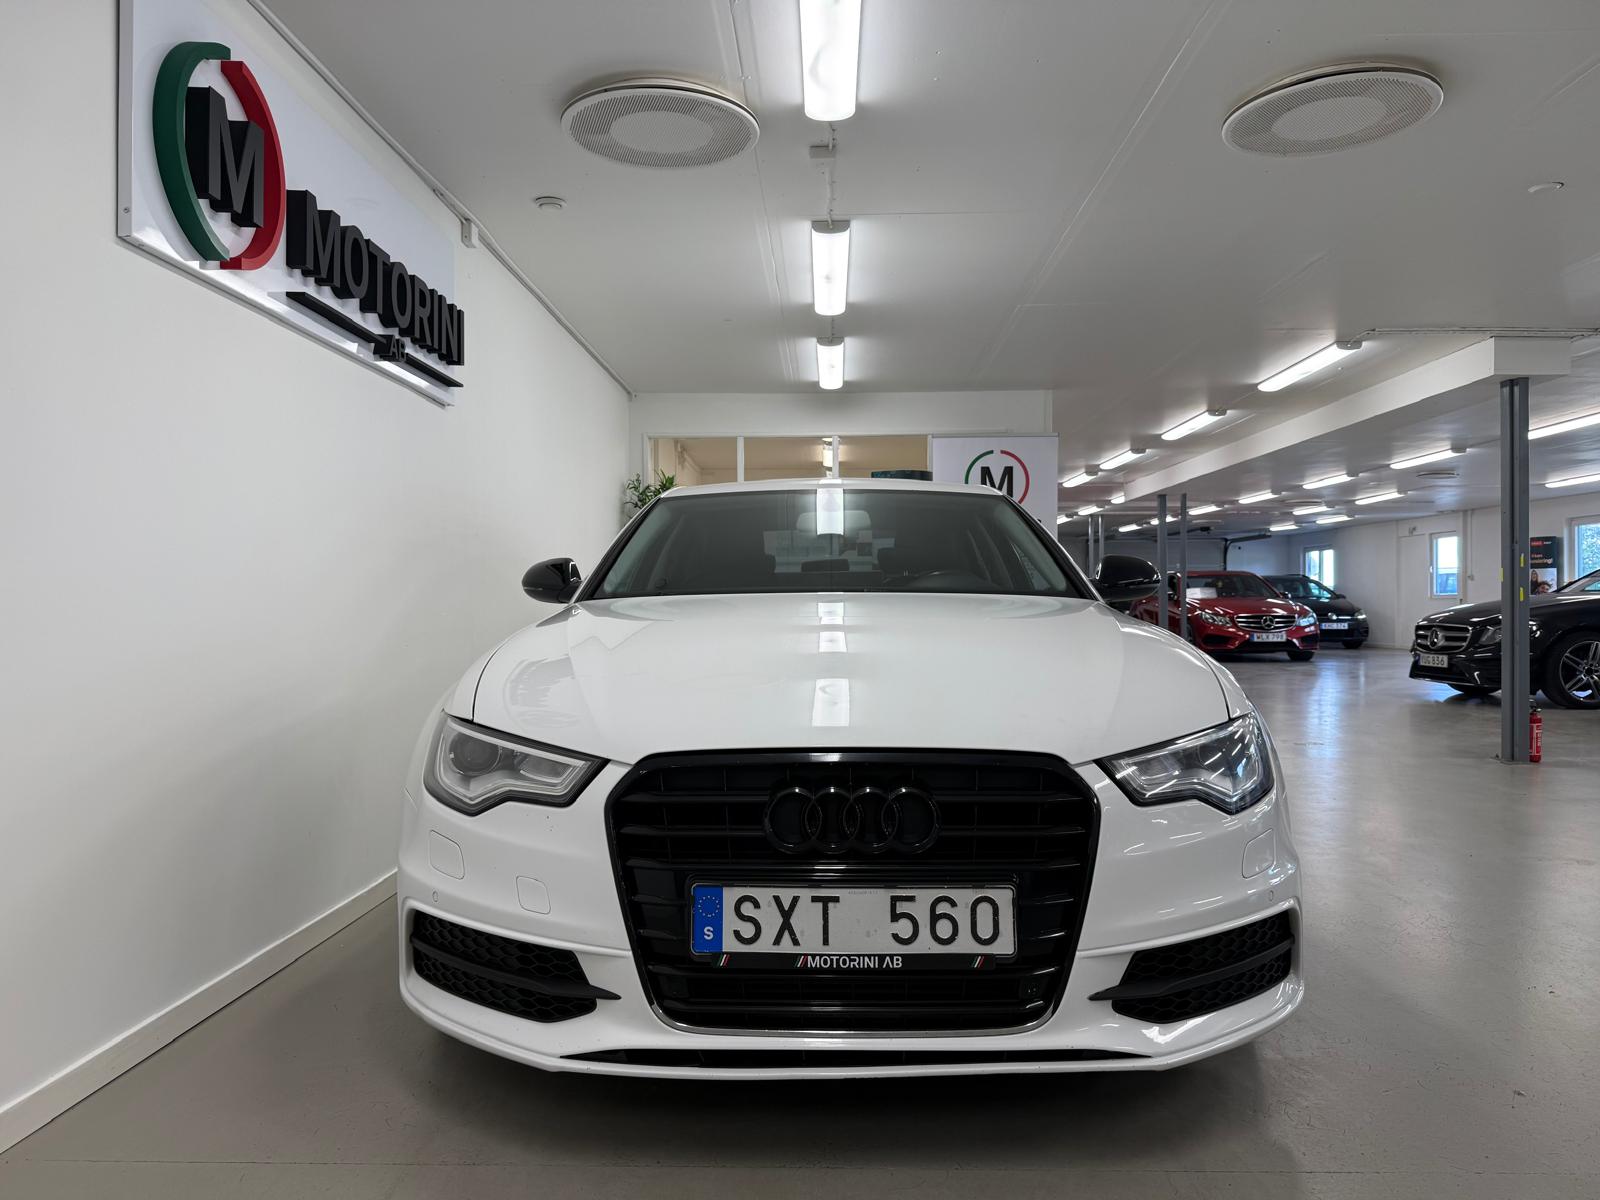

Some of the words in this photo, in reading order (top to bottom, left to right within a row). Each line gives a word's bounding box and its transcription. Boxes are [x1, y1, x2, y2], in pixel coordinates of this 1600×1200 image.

[195, 86, 264, 228] M
[288, 190, 464, 366] MOTORINI
[384, 335, 407, 362] AB
[980, 465, 1014, 498] M
[703, 926, 714, 940] S
[732, 894, 841, 946] SXT
[890, 894, 1000, 946] 560
[807, 955, 879, 969] MOTORINI
[882, 955, 903, 969] AB
